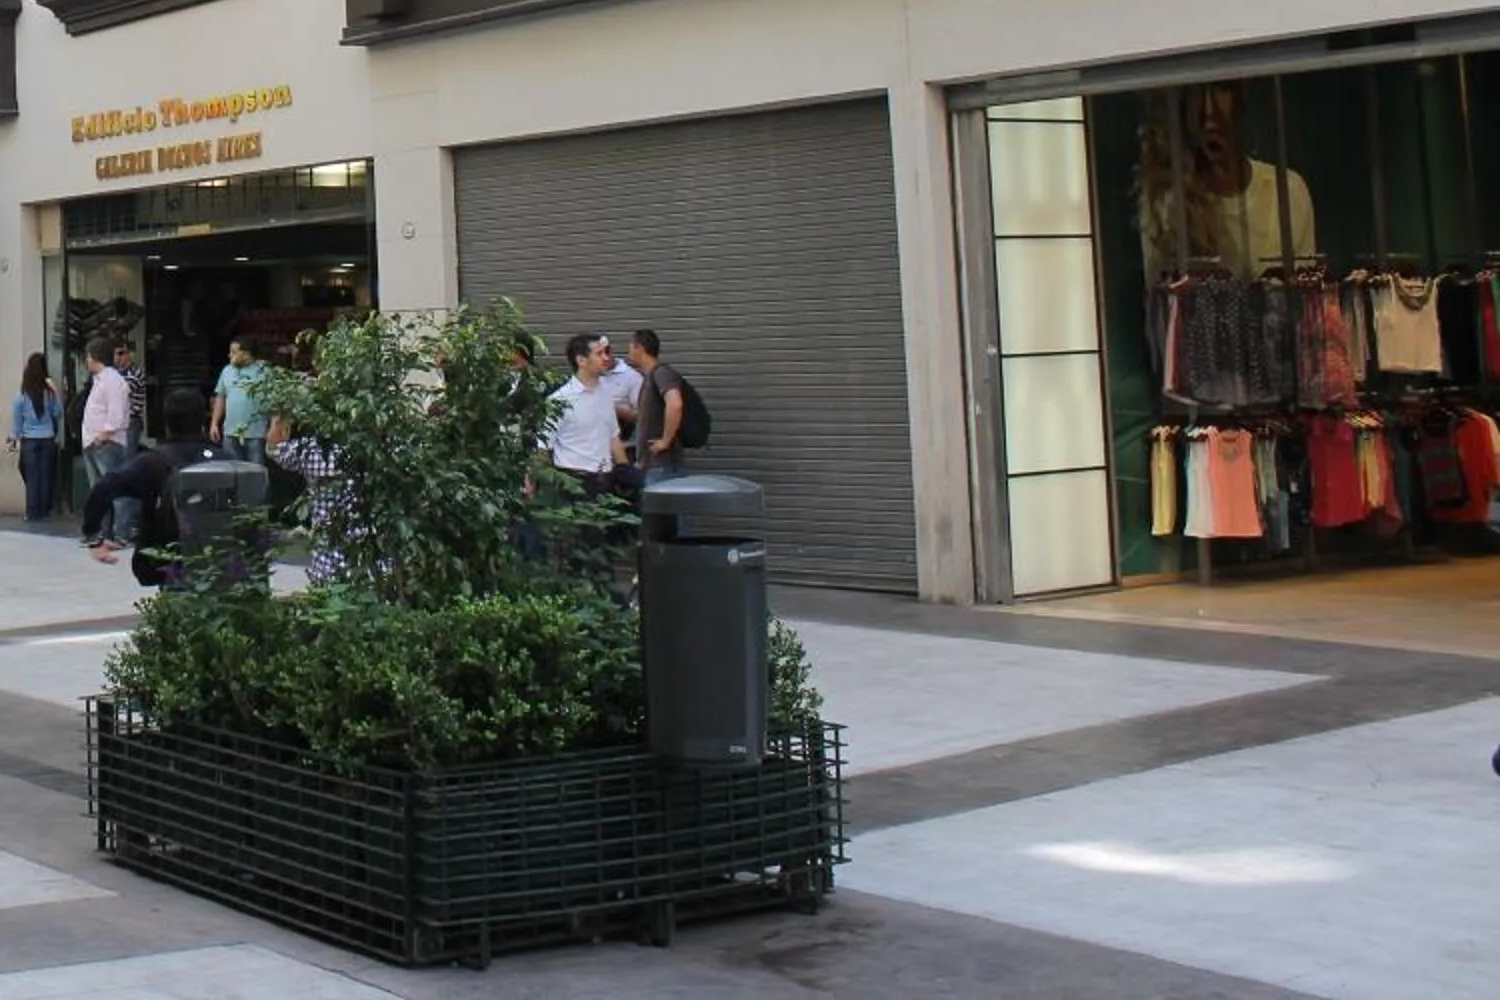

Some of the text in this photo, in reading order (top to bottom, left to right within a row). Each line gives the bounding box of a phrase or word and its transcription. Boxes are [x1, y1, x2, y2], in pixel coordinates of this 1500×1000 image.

[72, 85, 293, 142] Edificio Thompson
[96, 131, 262, 179] GALERIA BUENOS AIRES
